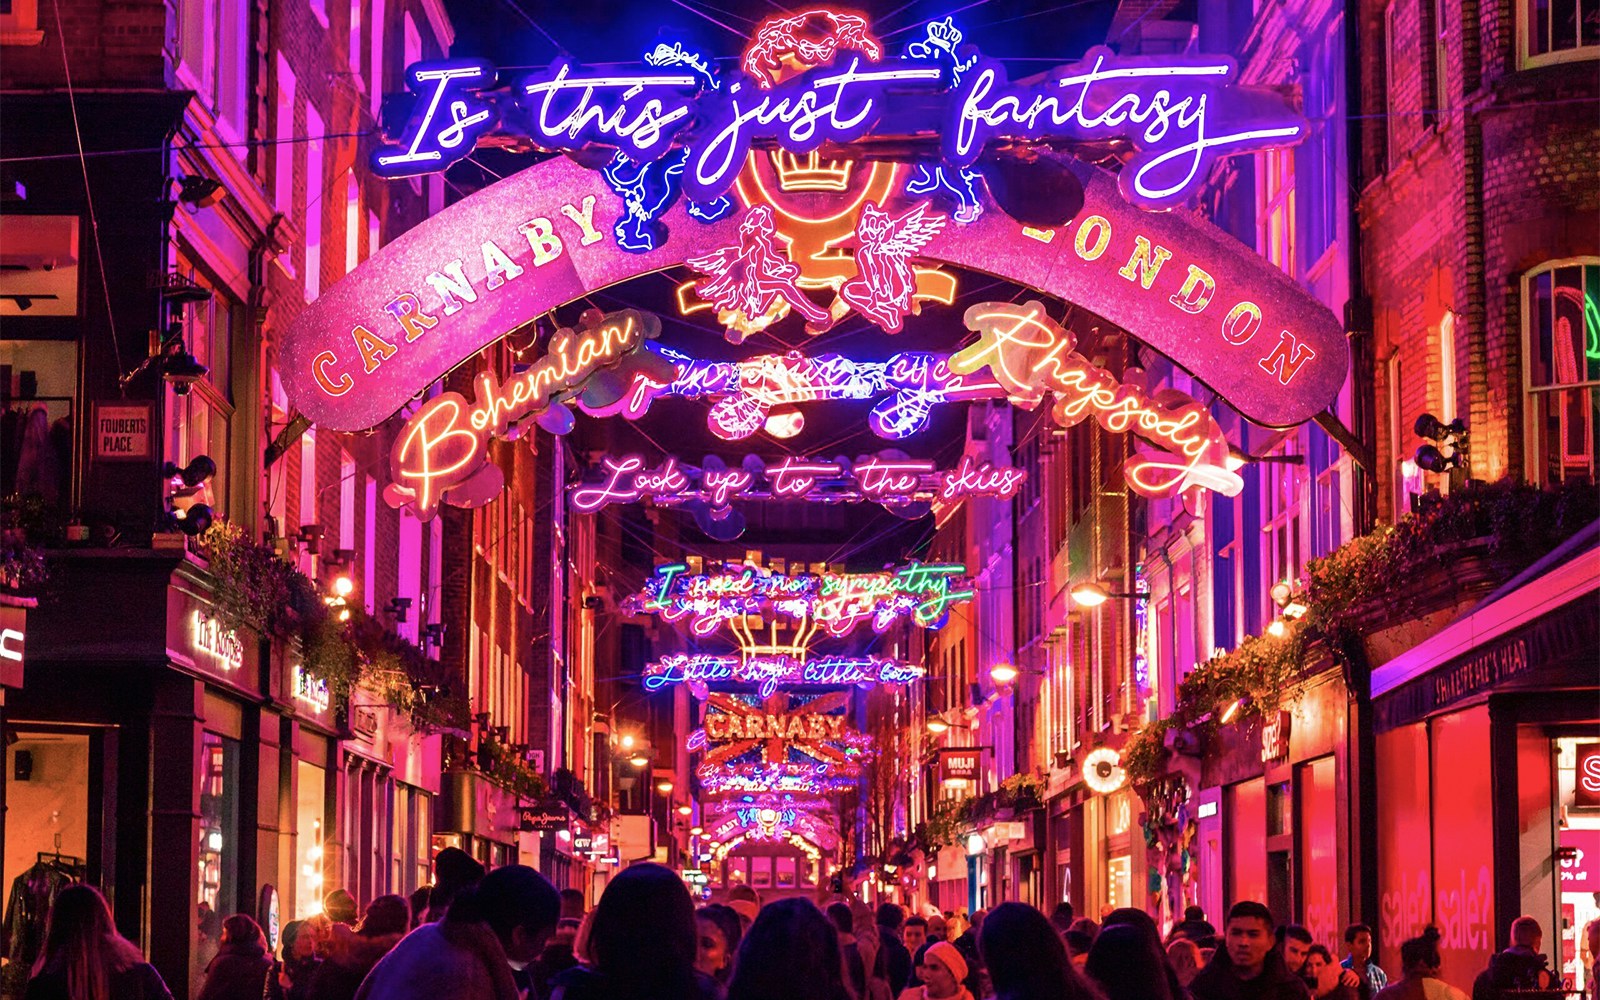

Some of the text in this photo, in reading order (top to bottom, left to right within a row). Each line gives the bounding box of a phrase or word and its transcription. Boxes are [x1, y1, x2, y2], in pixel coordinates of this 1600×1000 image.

[379, 56, 1300, 198] Is this just fantasy
[312, 196, 603, 396] CARNABY
[399, 317, 633, 509] Bohemian
[957, 309, 1244, 494] Rhapsody
[103, 436, 132, 452] PLACE
[574, 457, 1022, 508] Look up to the skies
[645, 564, 686, 608] I
[820, 561, 974, 626] sympathy
[1500, 639, 1527, 677] HEAD
[705, 714, 844, 739] CARNABY
[947, 757, 975, 769] MUJI
[1438, 865, 1490, 950] sale?
